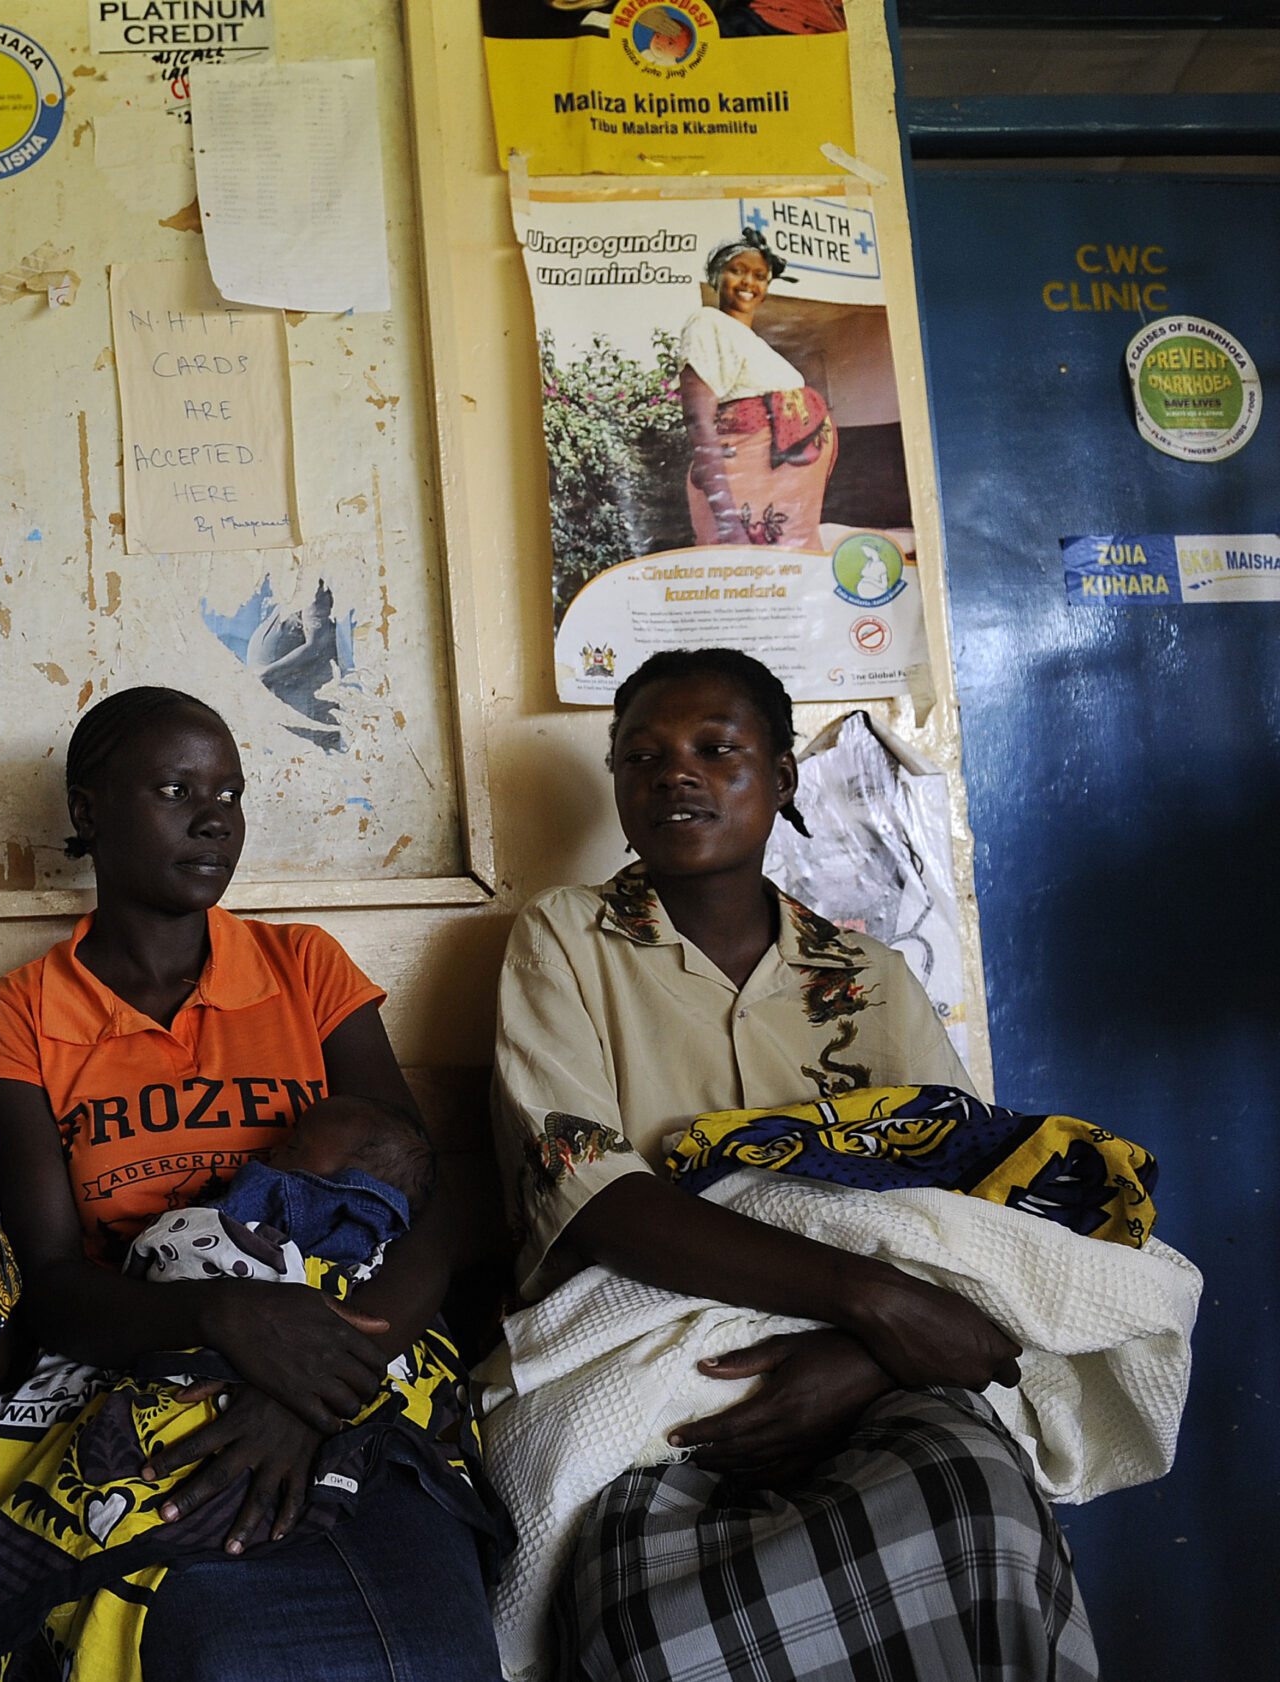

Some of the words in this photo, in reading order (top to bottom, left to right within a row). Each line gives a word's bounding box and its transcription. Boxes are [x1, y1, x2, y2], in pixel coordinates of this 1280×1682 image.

[100, 0, 265, 21] PLATINUM
[124, 23, 244, 44] CREDIT
[554, 89, 626, 113] Maliza
[634, 92, 710, 118] kipimo
[718, 91, 789, 112] kamili
[590, 117, 618, 134] Tibu
[623, 121, 678, 134] Malaria
[683, 120, 758, 134] Kikamilifu
[772, 201, 851, 238] HEALTH
[526, 230, 698, 258] Unapogundua
[775, 229, 851, 263] CENTRE
[537, 265, 583, 286] una
[1042, 281, 1169, 311] CLINIC
[1131, 327, 1166, 361] CAUSES
[1169, 322, 1183, 332] OF
[1187, 323, 1247, 369] DIARRHOEA
[152, 352, 248, 377] CARDS
[1146, 347, 1230, 370] PREVENT
[1148, 374, 1233, 396] DIARRHOEA
[184, 400, 231, 420] ARE
[1192, 398, 1222, 408] LIVES
[1248, 390, 1256, 414] FOOD
[1226, 424, 1248, 446] FLUIDS
[1183, 446, 1217, 454] FINGERS
[173, 482, 238, 503] HERE
[194, 515, 216, 542] By
[1097, 544, 1147, 566] ZUIA
[1180, 549, 1224, 575] OKOA
[1226, 551, 1280, 570] MAISHA
[707, 564, 775, 580] mpango
[778, 564, 803, 575] wa
[664, 586, 720, 602] kuzuia
[723, 584, 787, 599] malaria
[1081, 574, 1170, 596] KUHARA
[868, 670, 896, 680] Global
[58, 1076, 324, 1161] FROZEN
[109, 1153, 261, 1186] ADERCRON
